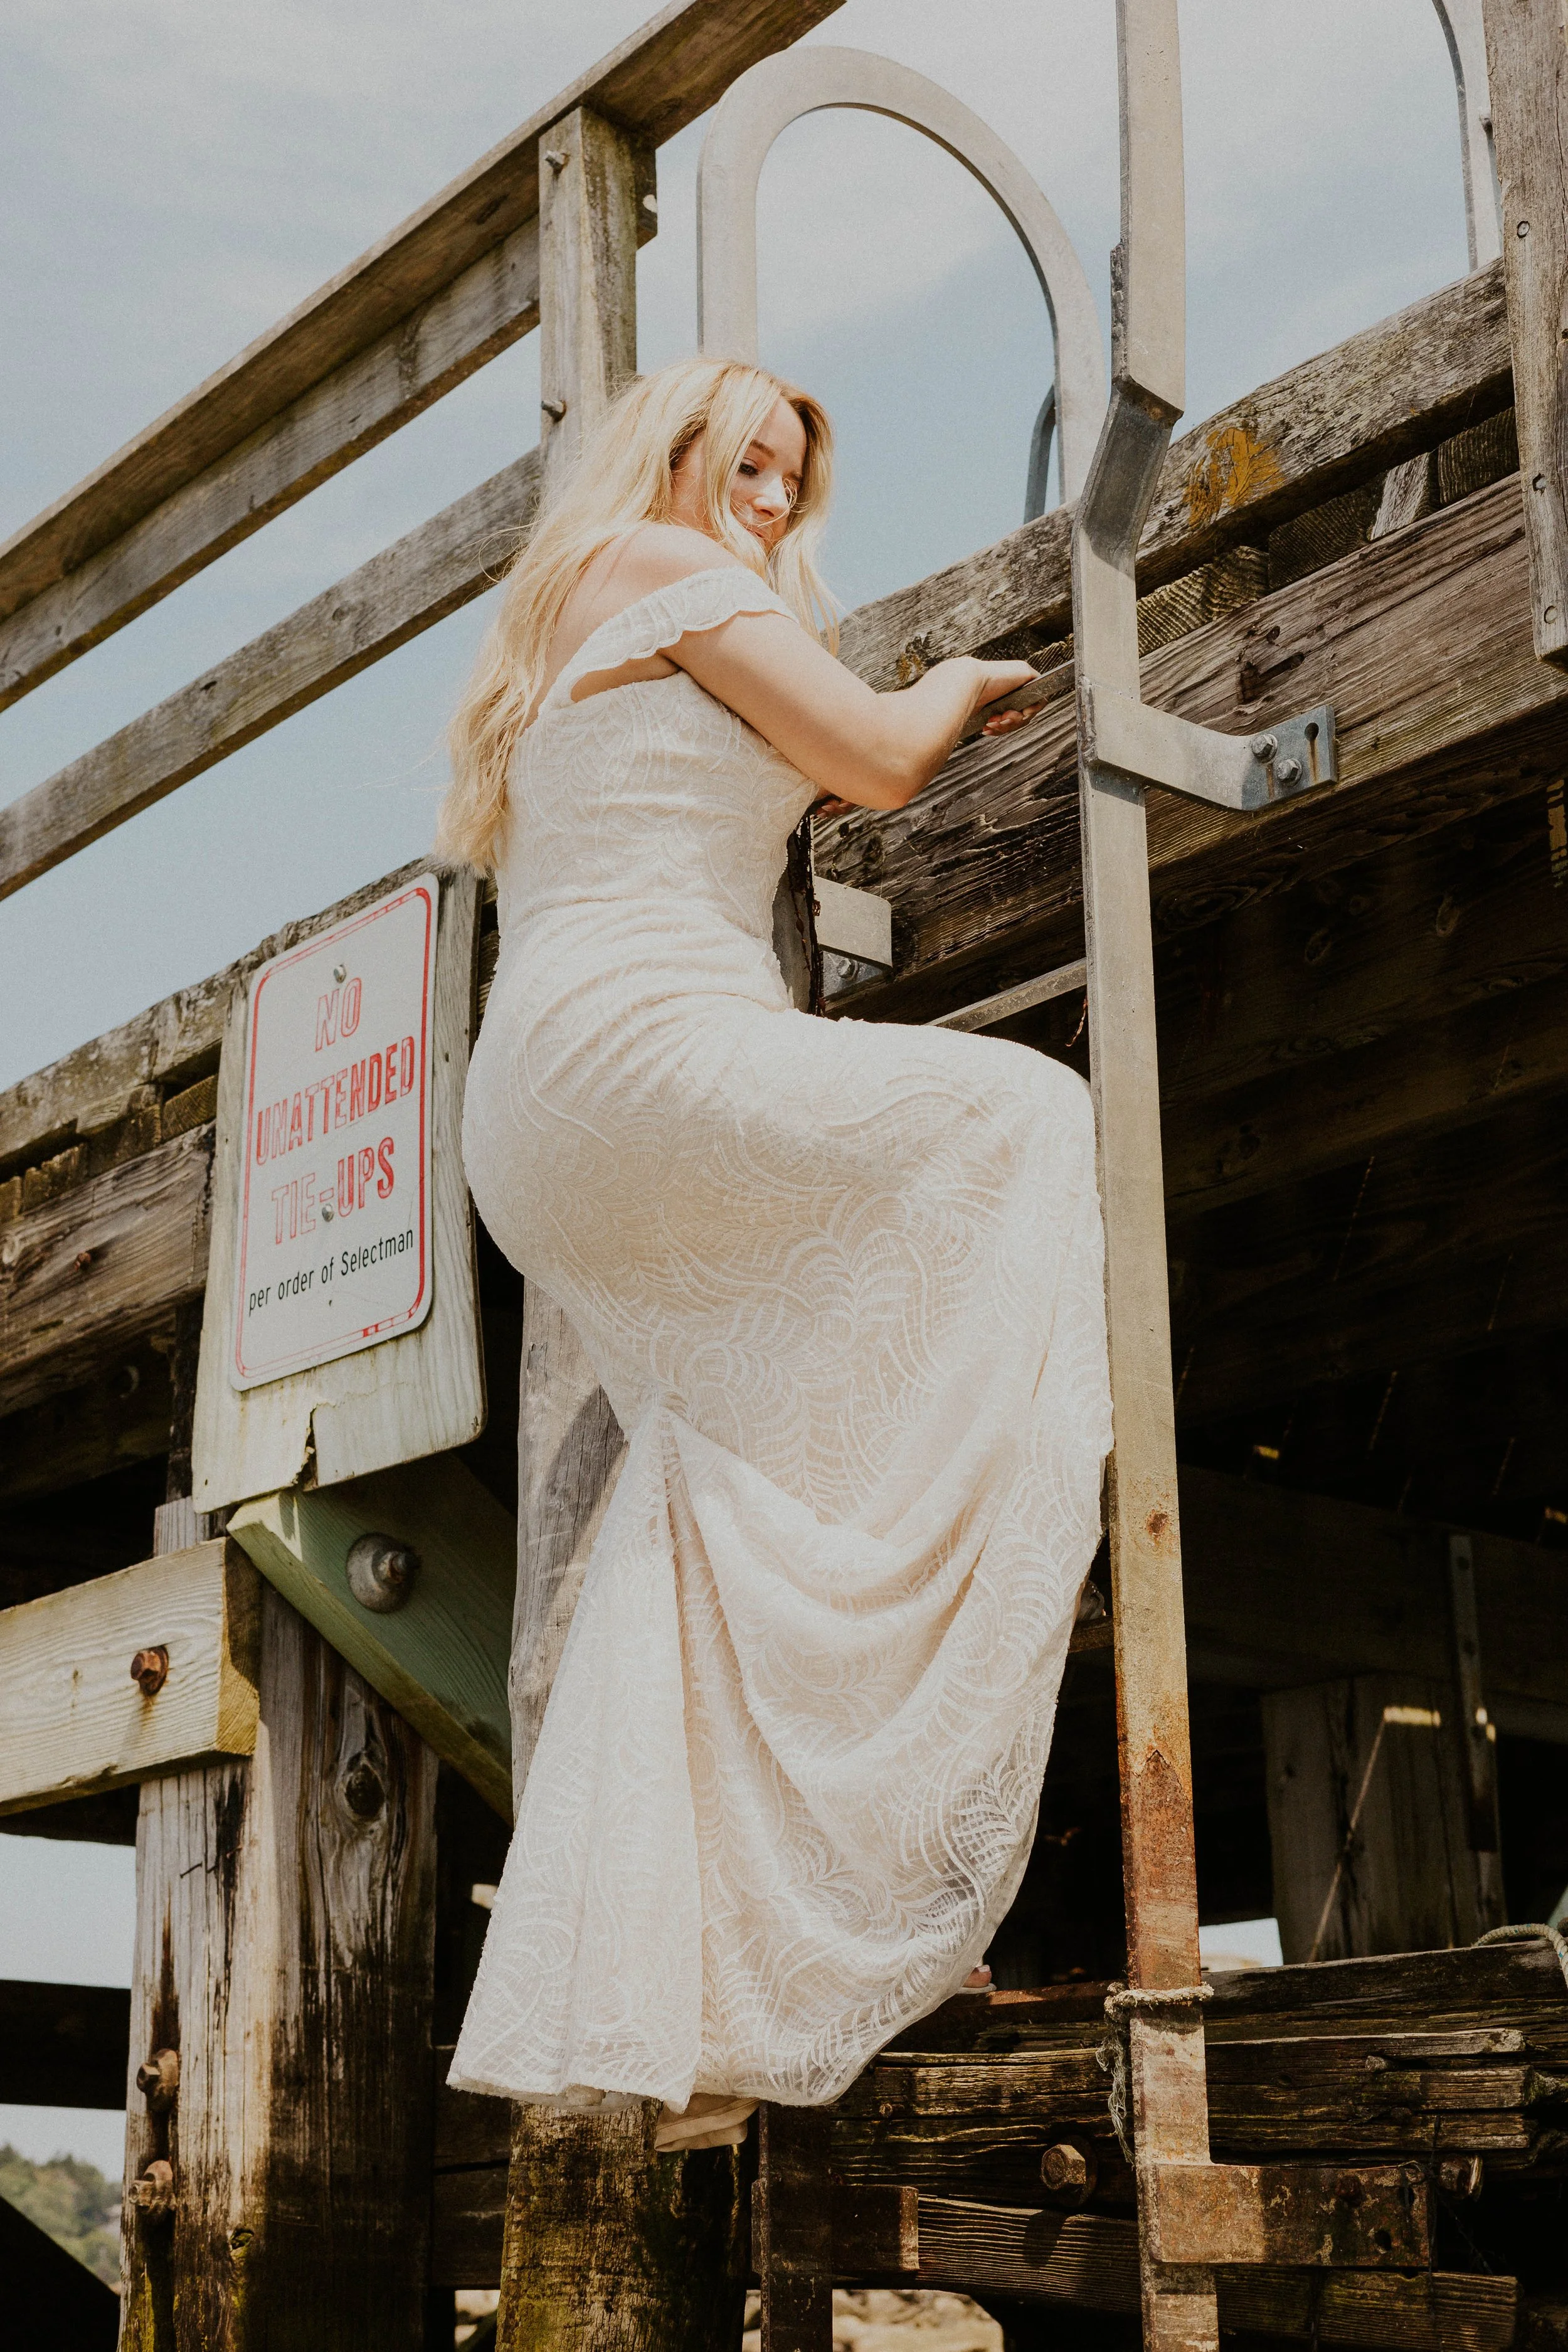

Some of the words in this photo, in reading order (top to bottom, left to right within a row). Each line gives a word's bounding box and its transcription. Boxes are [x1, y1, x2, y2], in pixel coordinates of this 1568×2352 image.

[315, 977, 362, 1052] NO
[257, 1036, 415, 1165] UNATTENDED
[272, 1136, 395, 1245] TIE-UPS
[249, 1287, 271, 1317] per
[278, 1269, 314, 1300] order
[321, 1257, 334, 1284] of
[341, 1229, 413, 1276] Selectman
